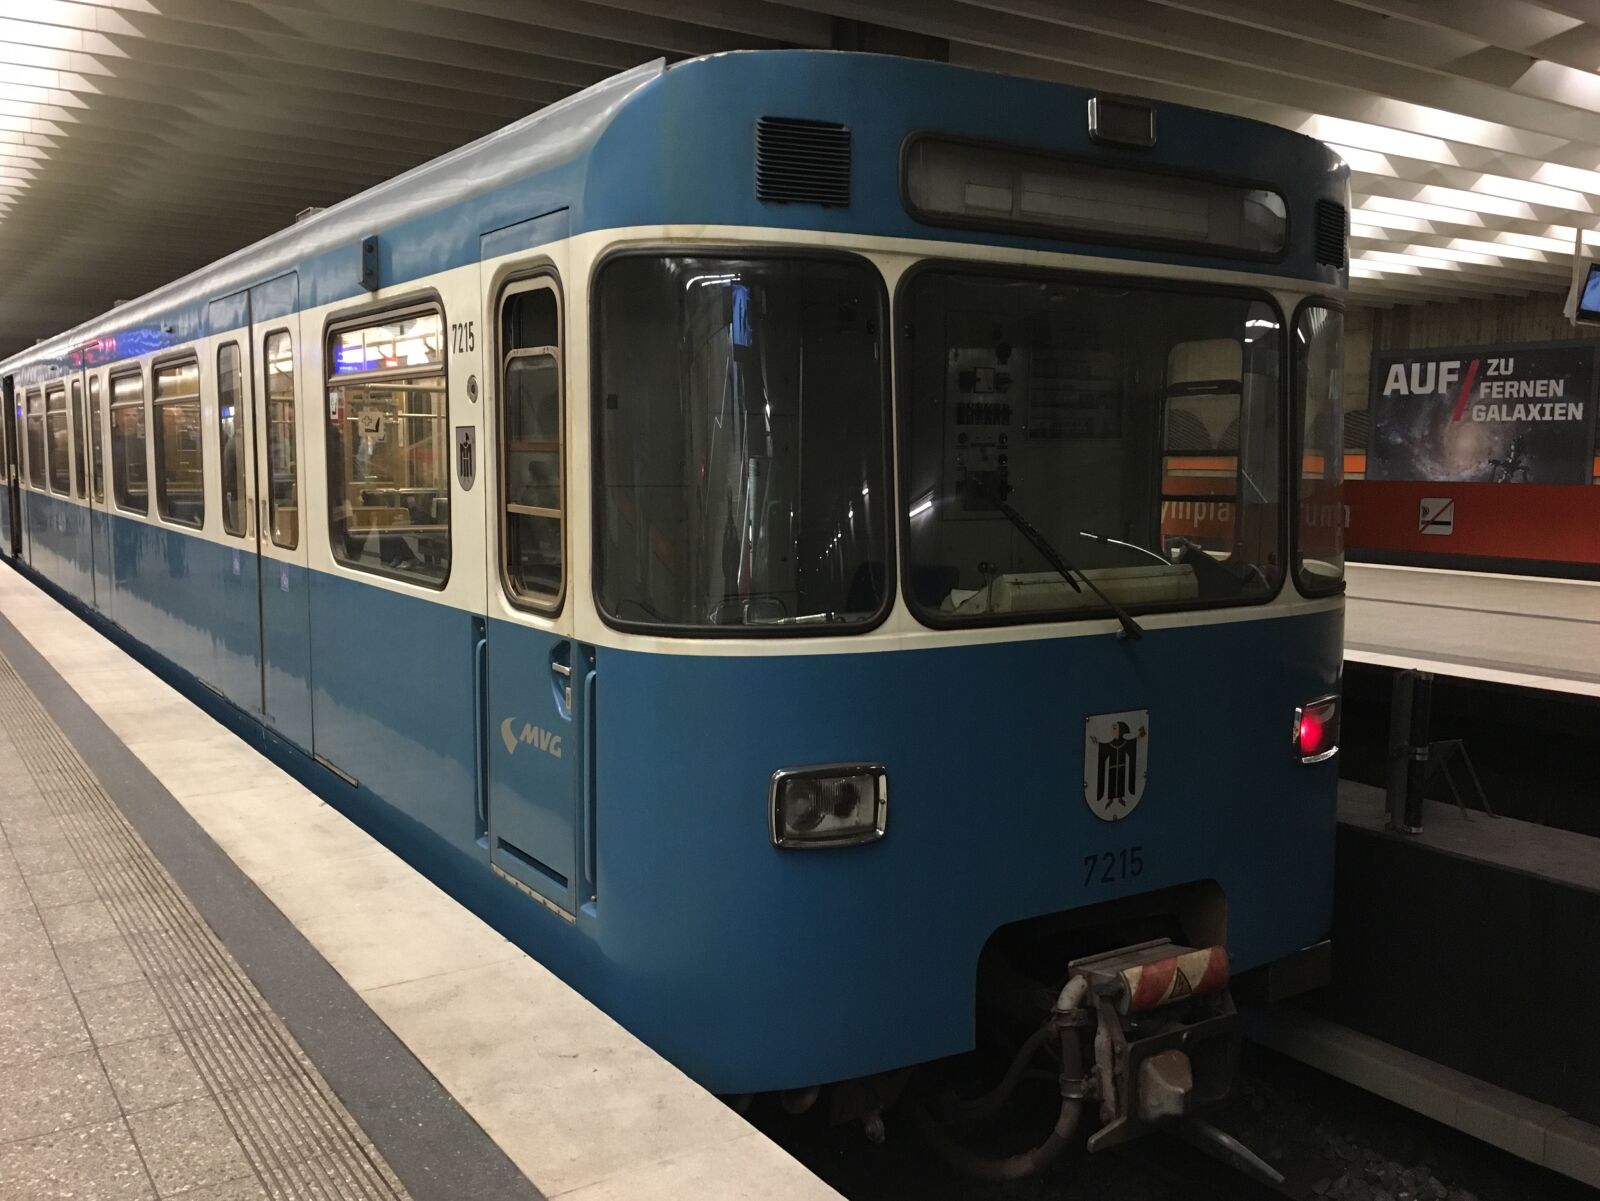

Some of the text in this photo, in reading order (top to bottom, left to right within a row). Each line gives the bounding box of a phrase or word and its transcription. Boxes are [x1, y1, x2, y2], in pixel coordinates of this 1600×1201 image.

[452, 321, 475, 354] 7215
[1383, 361, 1461, 396] AUF
[1486, 358, 1514, 376] ZU
[1480, 379, 1564, 399] FERNEN
[1472, 403, 1583, 422] GALAXIEN
[519, 722, 562, 758] MVG
[1084, 846, 1143, 887] 7215
